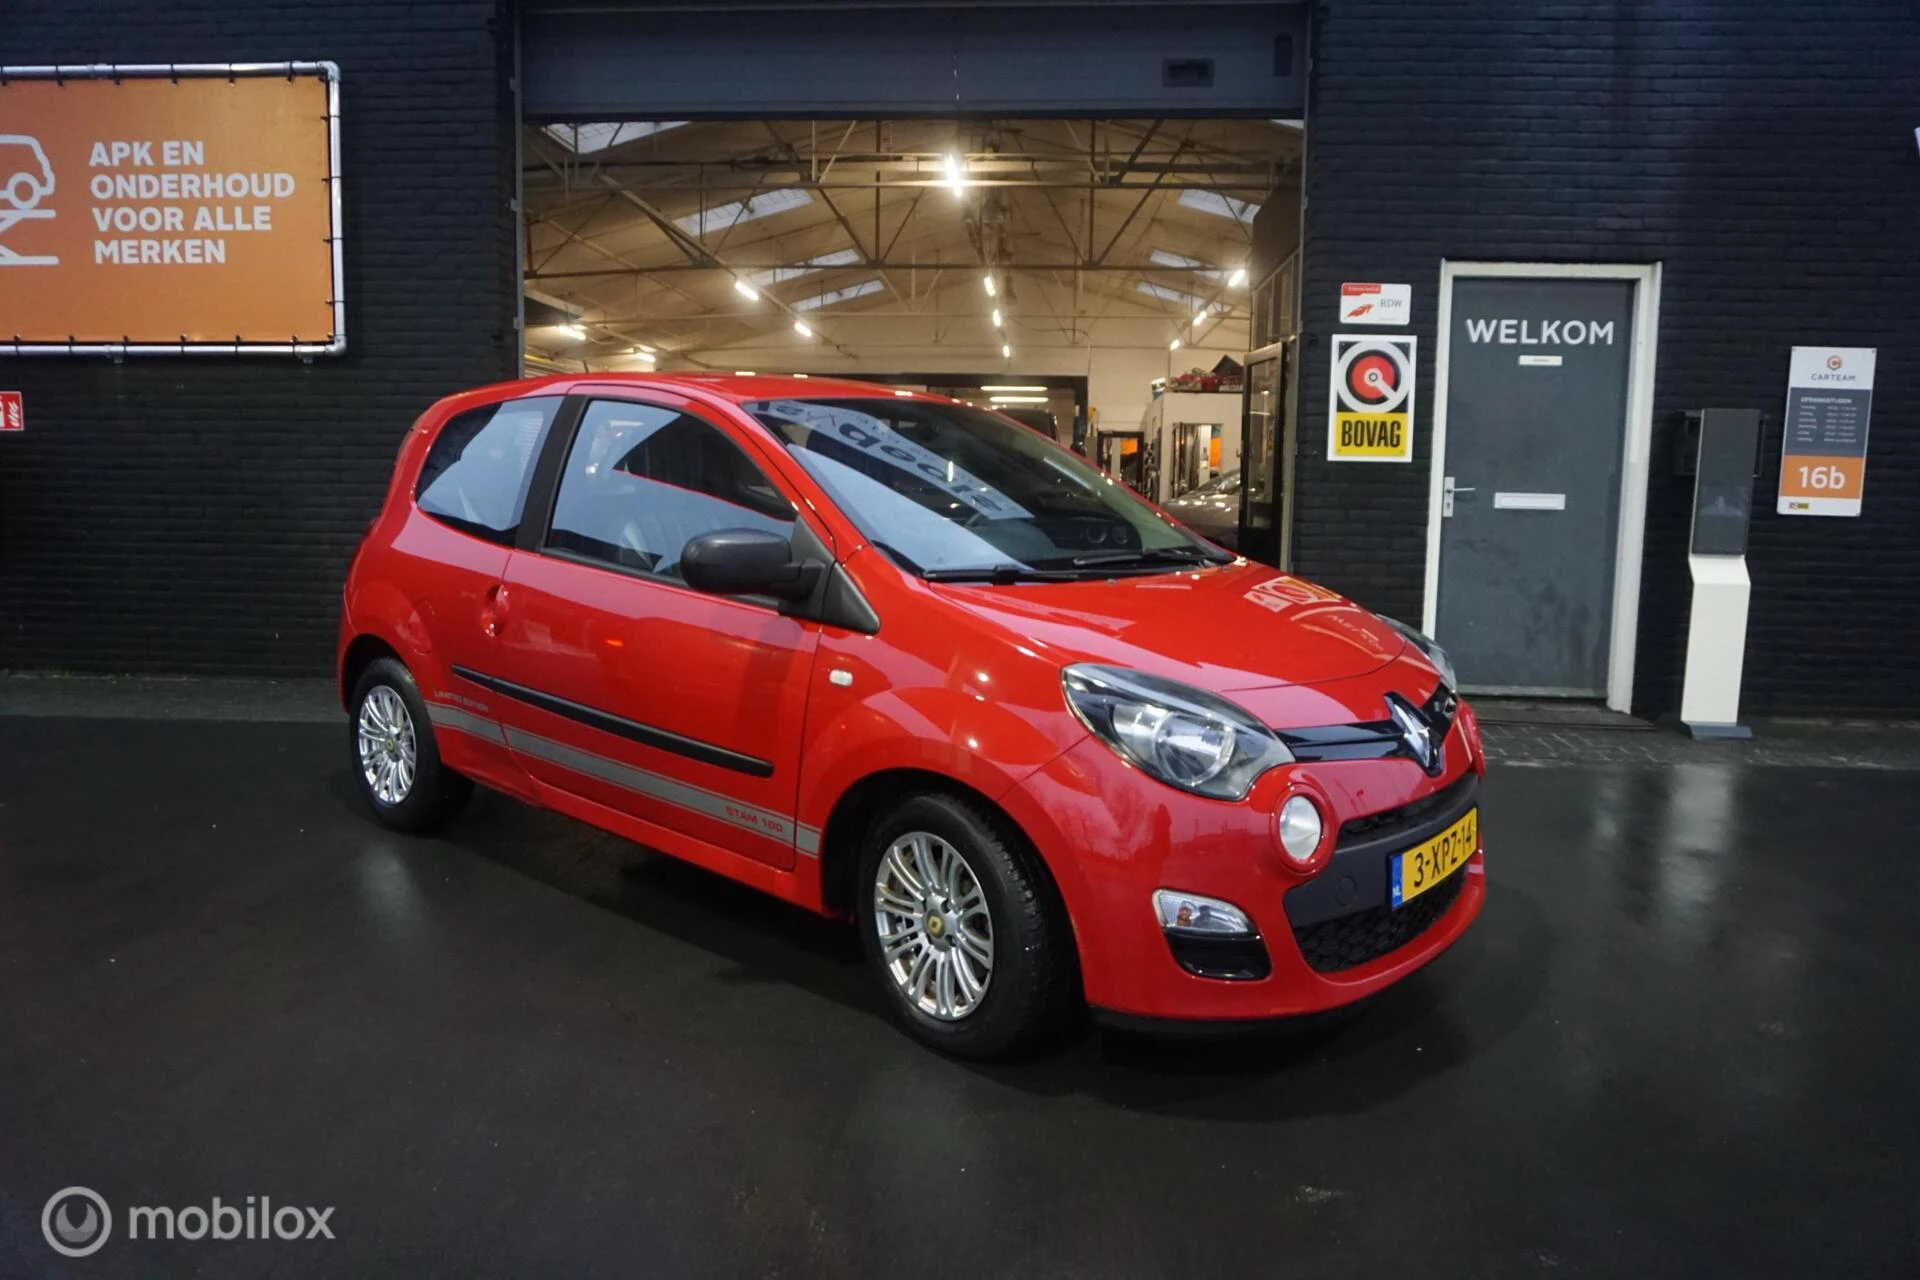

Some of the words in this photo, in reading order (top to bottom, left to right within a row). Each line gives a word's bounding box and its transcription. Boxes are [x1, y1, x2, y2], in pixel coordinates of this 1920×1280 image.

[89, 141, 154, 167] APK
[162, 140, 205, 166] EN
[90, 172, 296, 199] ONDERHOUD
[92, 207, 184, 232] VOOR
[193, 205, 272, 232] ALLE
[94, 239, 226, 265] MERKEN
[1380, 299, 1403, 308] RDW
[1465, 318, 1615, 345] WELKOM
[1811, 373, 1856, 381] CARTEAM
[1341, 419, 1402, 448] BOVAG
[1799, 466, 1846, 490] 16b
[1413, 819, 1472, 888] 3-XPZ-14
